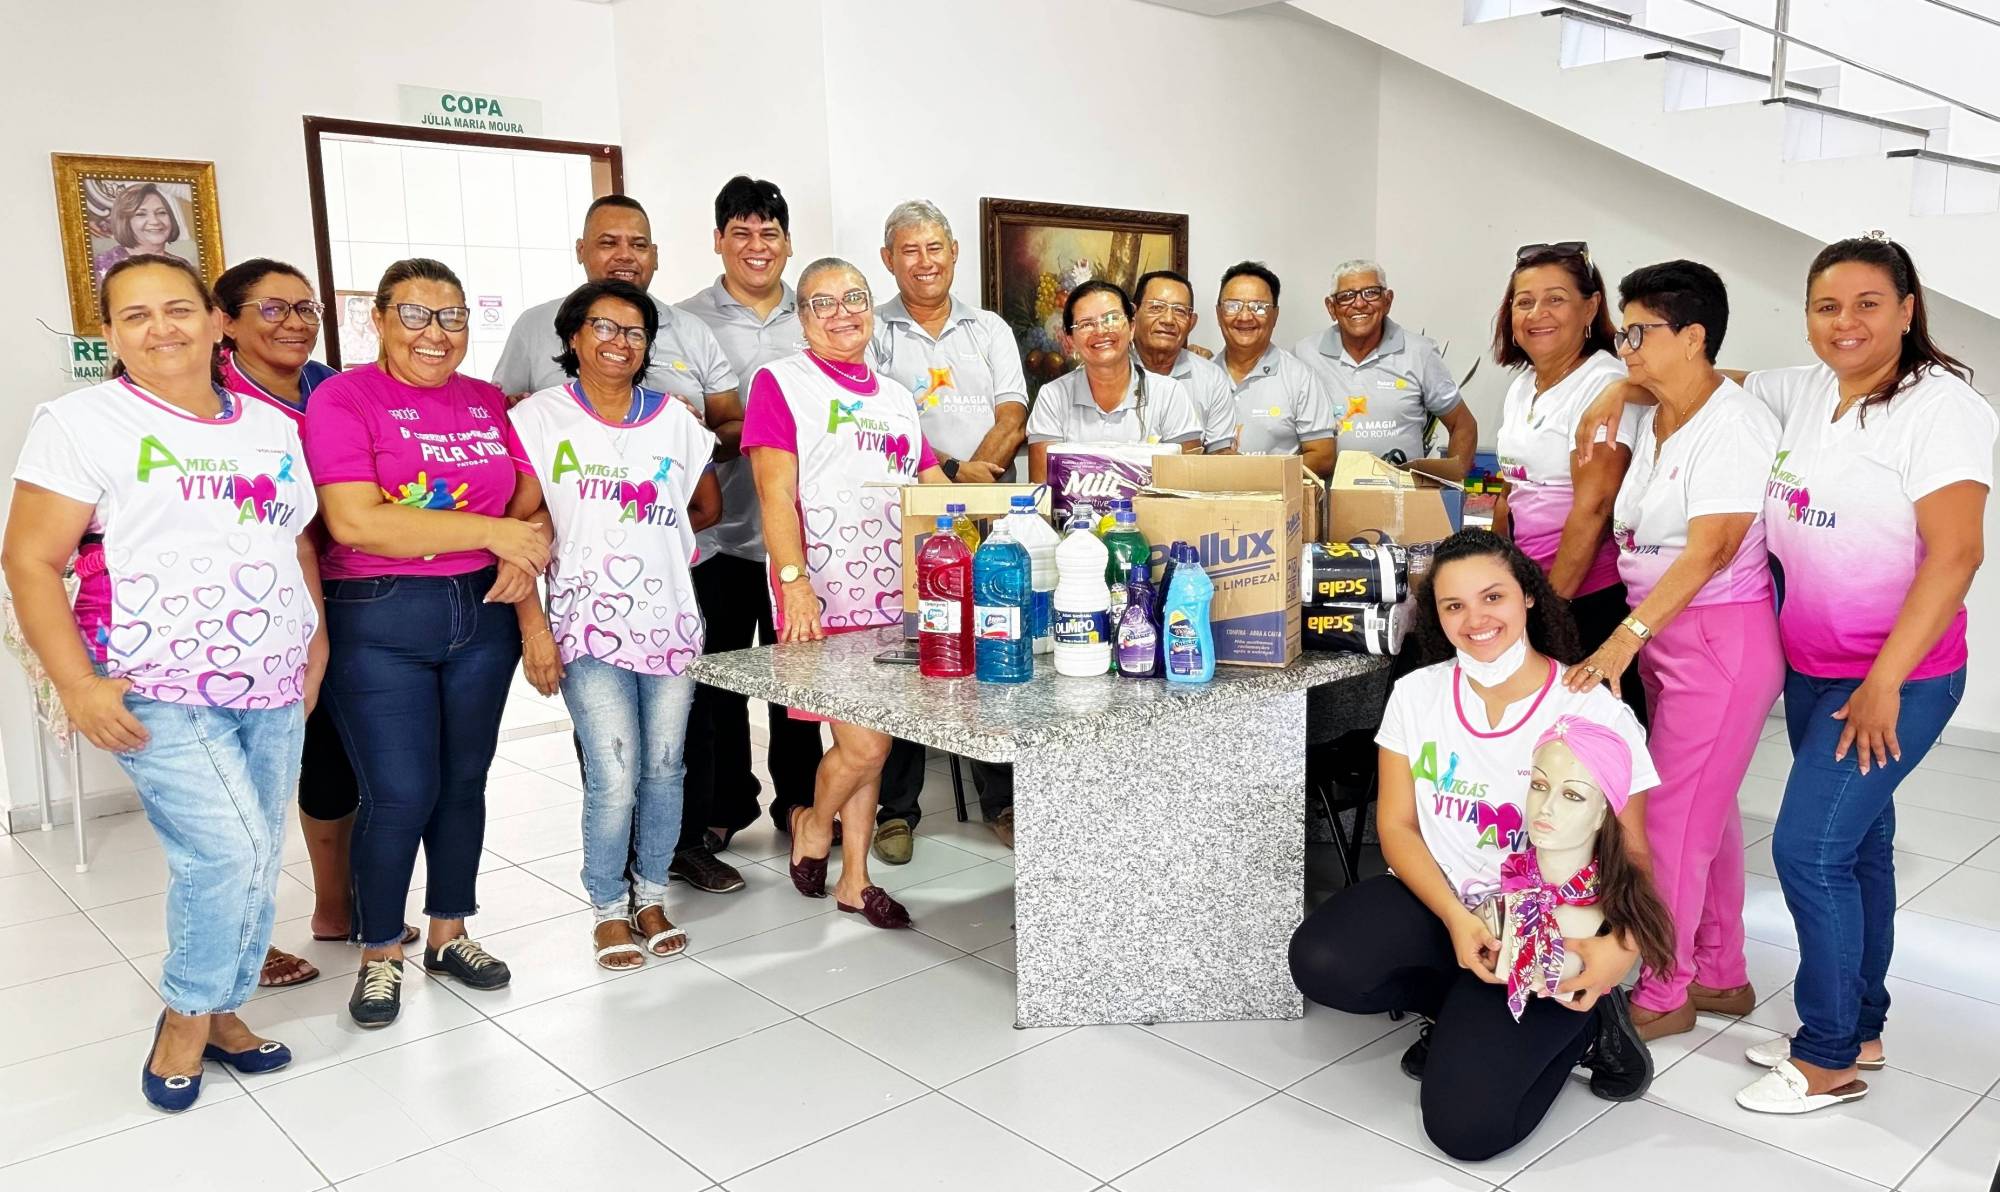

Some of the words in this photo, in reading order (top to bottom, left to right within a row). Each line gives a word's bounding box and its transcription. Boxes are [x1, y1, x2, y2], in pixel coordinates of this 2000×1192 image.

[441, 94, 503, 117] COPA
[421, 112, 451, 127] JÚLIA
[454, 117, 487, 130] MARIA
[489, 121, 524, 134] MOURA
[73, 341, 109, 361] RE
[952, 395, 989, 405] MAGIA
[1355, 430, 1369, 439] DO
[1356, 421, 1364, 430] A
[1365, 420, 1397, 430] MAGIA
[449, 433, 457, 442] E
[854, 431, 887, 454] VIVA
[420, 442, 469, 463] PELA
[176, 474, 234, 501] VIVA
[576, 479, 621, 501] VIVA
[618, 501, 639, 524] A
[1801, 507, 1837, 529] VIDA
[1223, 571, 1281, 592] LIMPEZA!
[1318, 578, 1368, 598] Scala
[1055, 619, 1095, 634] OLIMPO
[1307, 615, 1355, 635] Scala
[1432, 793, 1479, 825] VIVA
[1476, 825, 1500, 850] A
